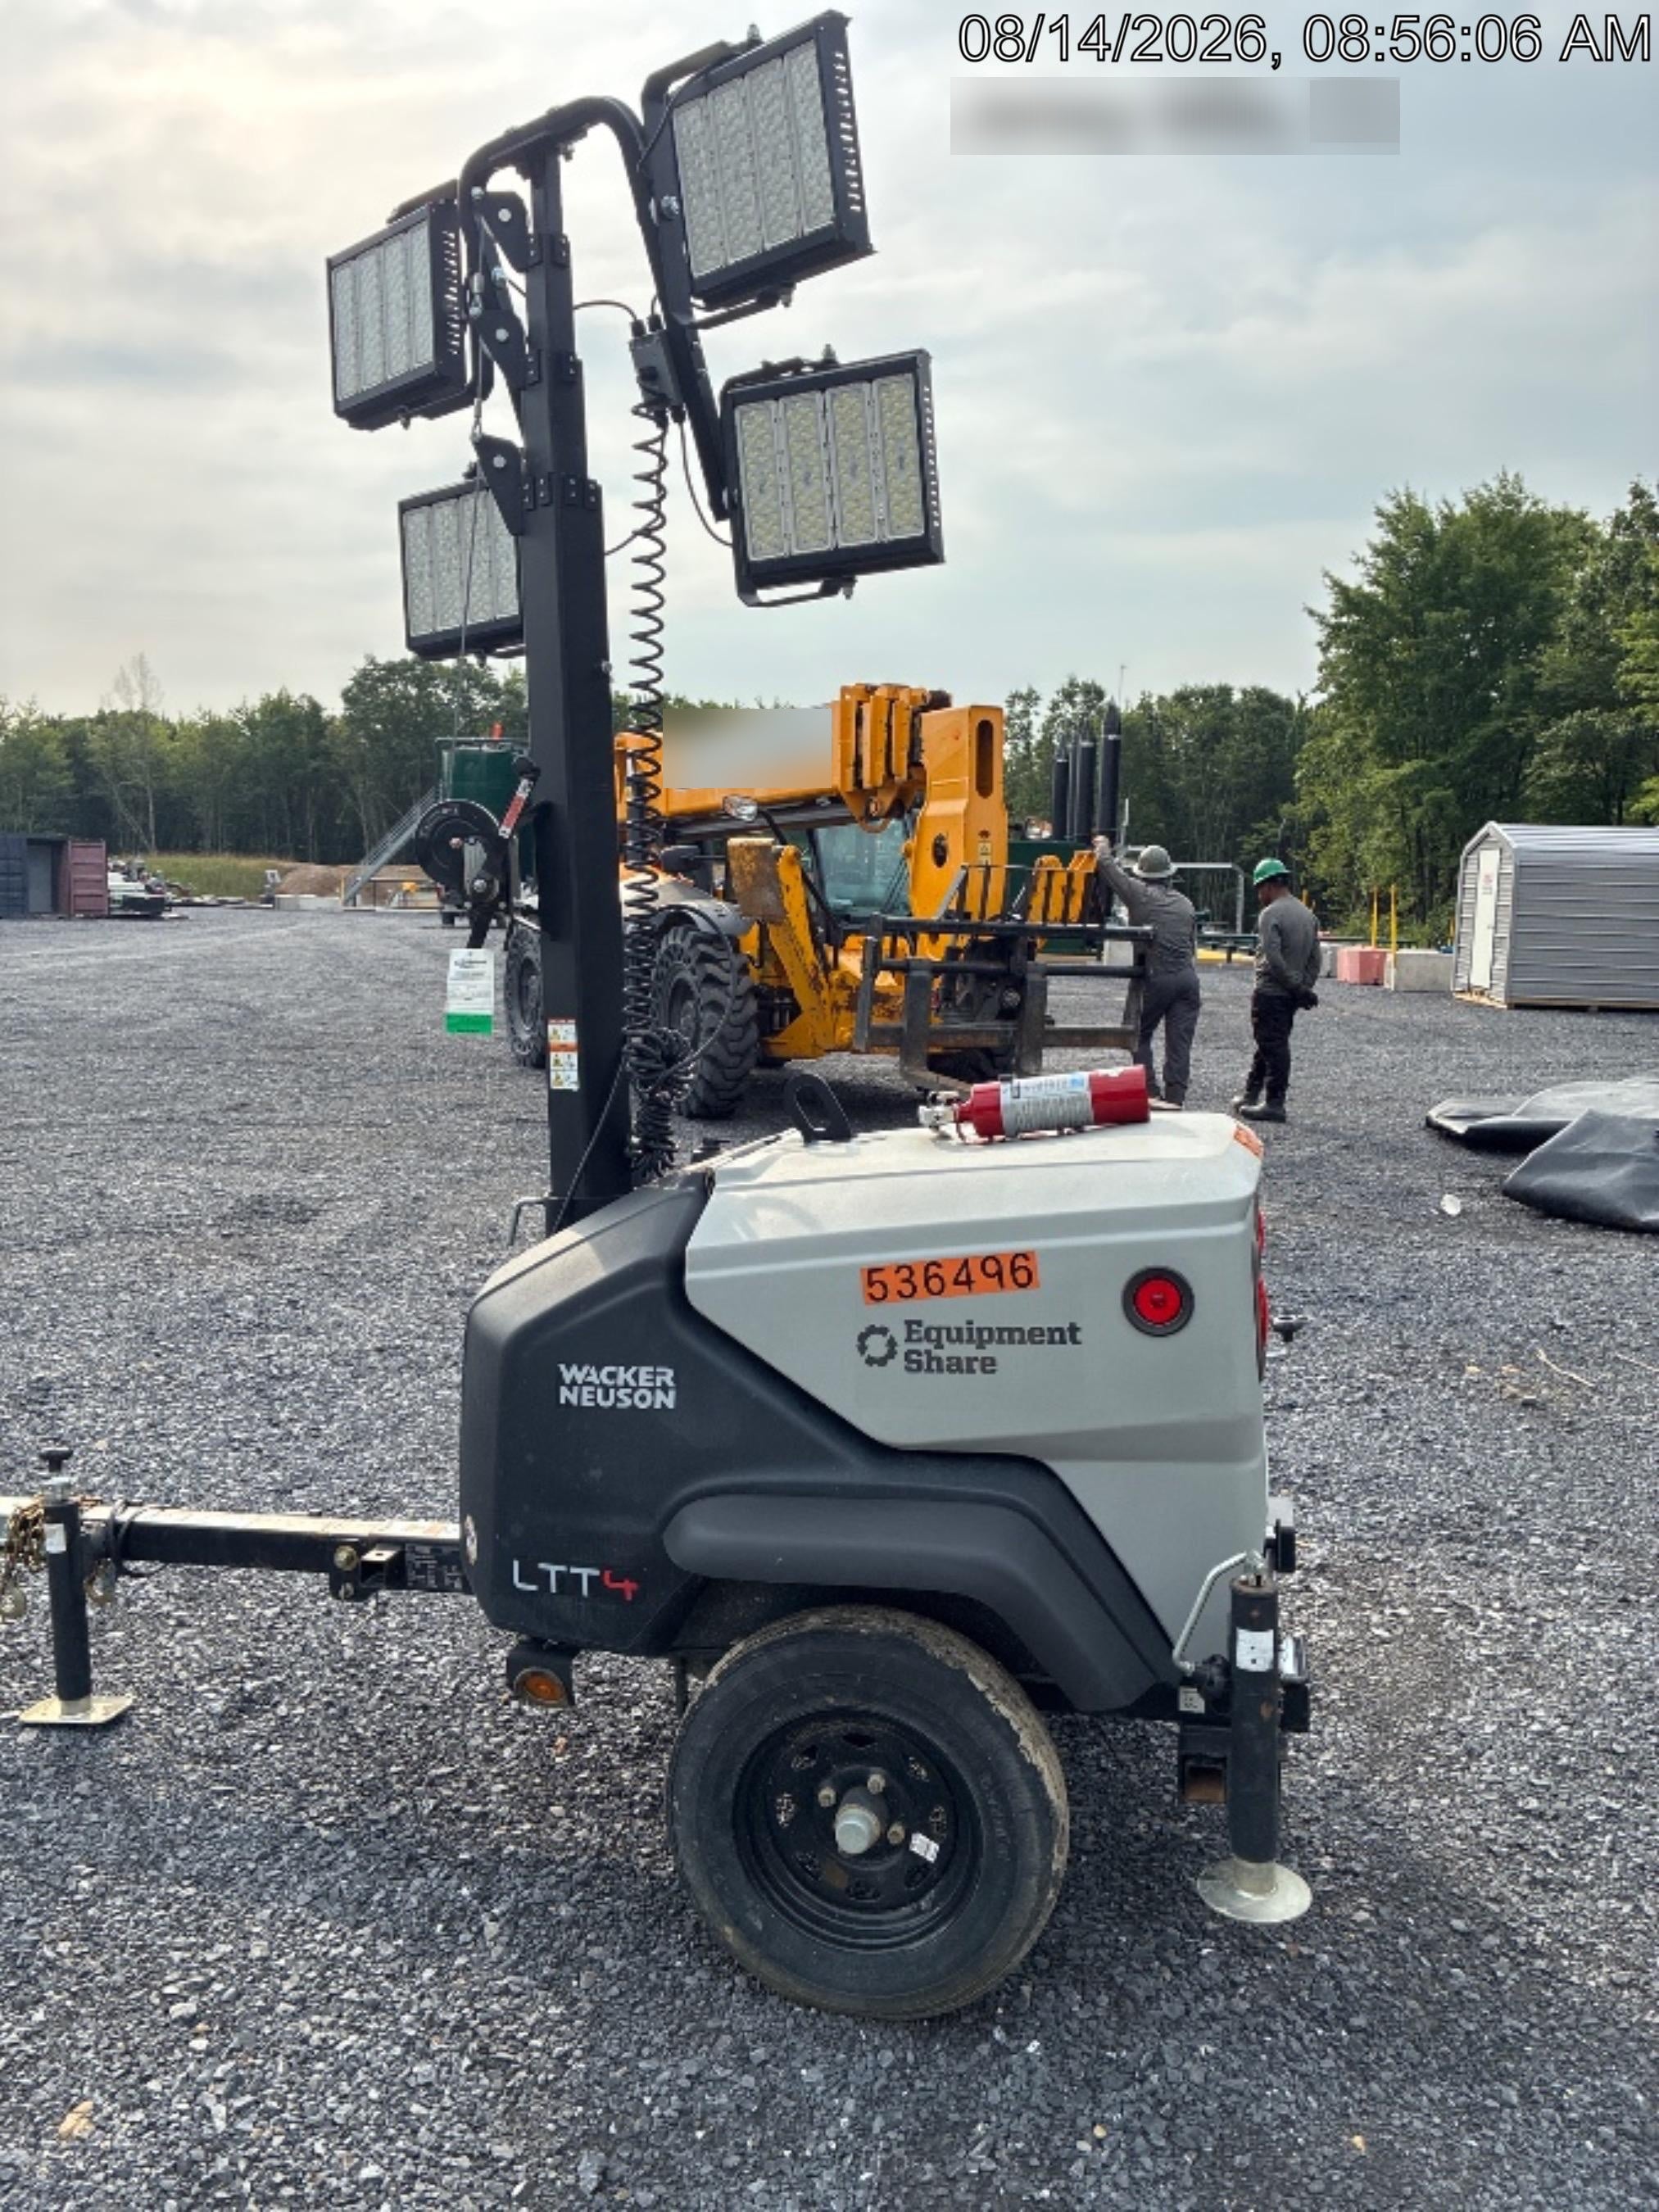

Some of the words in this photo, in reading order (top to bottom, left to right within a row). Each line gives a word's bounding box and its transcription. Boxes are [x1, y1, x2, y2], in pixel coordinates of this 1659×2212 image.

[866, 1253, 1034, 1302] 536496
[904, 1319, 1082, 1349] Equipment
[558, 1363, 675, 1388] WACKER
[904, 1349, 997, 1375] Share
[559, 1386, 676, 1409] NEUSON
[512, 1559, 639, 1602] LTT4
